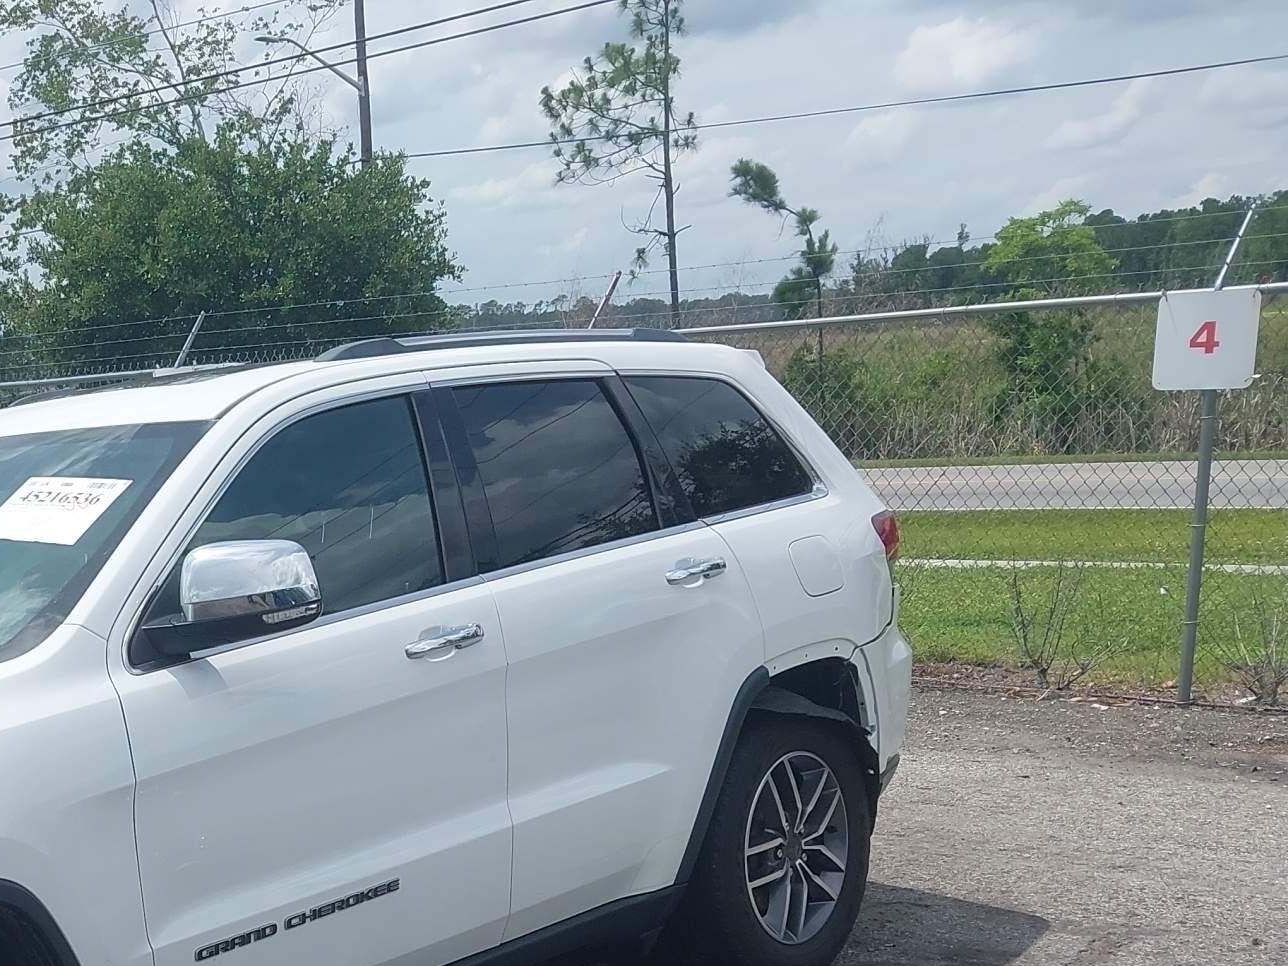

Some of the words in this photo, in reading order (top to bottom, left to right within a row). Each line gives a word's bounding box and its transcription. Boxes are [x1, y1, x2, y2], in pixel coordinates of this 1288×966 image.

[1189, 321, 1220, 354] 4
[20, 490, 103, 505] 45216536
[194, 922, 278, 961] GRAND
[284, 878, 400, 930] CHEROKEE
